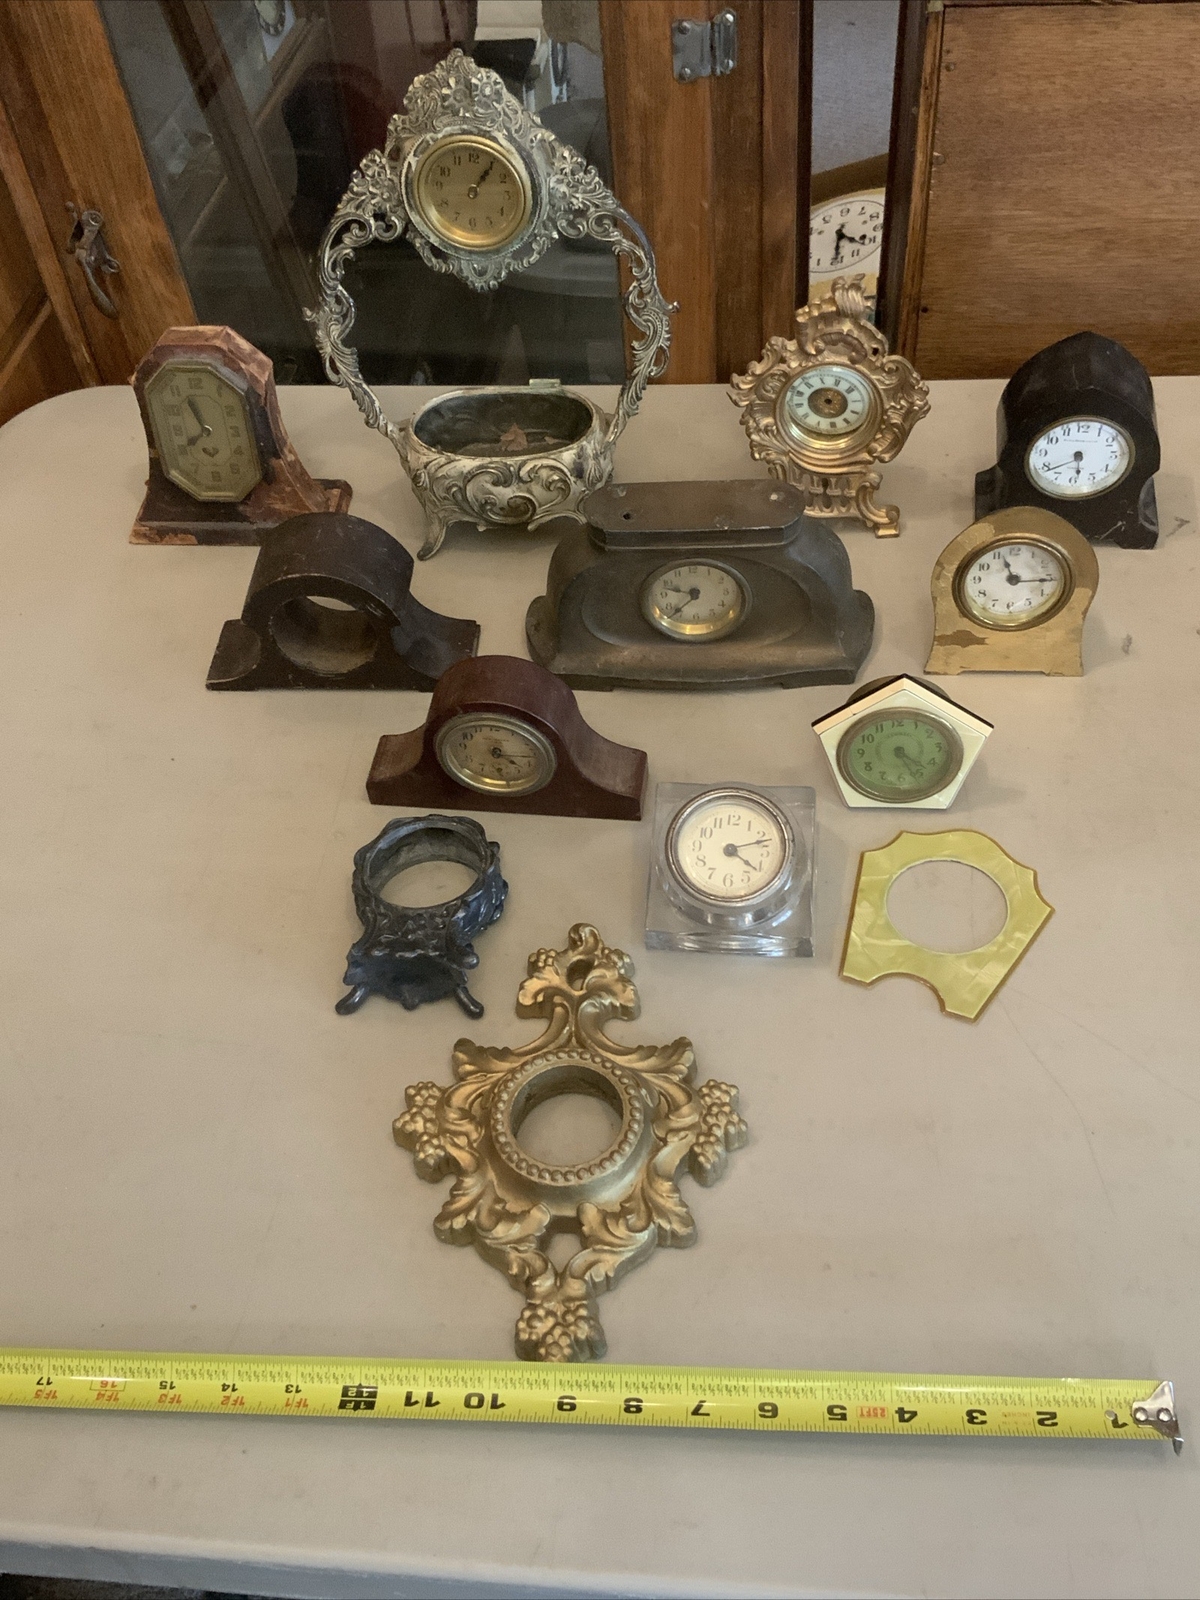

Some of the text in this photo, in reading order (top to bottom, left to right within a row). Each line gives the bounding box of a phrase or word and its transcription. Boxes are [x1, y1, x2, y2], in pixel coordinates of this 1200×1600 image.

[454, 155, 462, 166] 11
[468, 153, 480, 164] 12
[440, 167, 451, 177] 10
[436, 181, 443, 191] 9
[840, 208, 850, 217] 6
[858, 206, 867, 216] 7
[469, 217, 476, 228] 6
[852, 249, 860, 257] 11
[1063, 427, 1071, 437] 11
[1077, 422, 1090, 433] 12
[1097, 425, 1103, 437] 1
[1047, 434, 1059, 445] 10
[1106, 437, 1115, 447] 2
[1039, 448, 1048, 457] 9
[1042, 462, 1051, 472] 8
[1054, 472, 1062, 481] 7
[1069, 476, 1077, 485] 6
[1088, 473, 1096, 481] 5
[993, 552, 1001, 560] 11
[1009, 547, 1021, 556] 12
[689, 566, 698, 574] 12
[708, 568, 711, 576] 1
[978, 563, 990, 572] 10
[663, 579, 673, 587] 10
[718, 576, 724, 585] 2
[973, 575, 982, 584] 9
[660, 591, 668, 599] 9
[723, 588, 729, 596] 3
[978, 589, 987, 598] 8
[666, 602, 673, 610] 8
[718, 600, 726, 608] 4
[992, 599, 999, 607] 7
[1024, 598, 1032, 607] 5
[875, 723, 884, 734] 11
[891, 720, 904, 728] 12
[914, 721, 918, 730] 1
[861, 733, 875, 744] 10
[926, 729, 934, 739] 2
[934, 742, 942, 753] 3
[857, 748, 865, 758] 9
[864, 761, 872, 772] 8
[927, 757, 939, 767] 4
[879, 771, 887, 781] 7
[898, 773, 906, 783] 6
[916, 769, 924, 779] 5
[714, 817, 723, 829] 11
[727, 814, 741, 826] 12
[747, 820, 752, 832] 1
[700, 827, 713, 839] 10
[692, 840, 702, 852] 9
[695, 854, 707, 868] 8
[707, 868, 717, 880] 7
[741, 871, 751, 884] 5
[723, 873, 734, 888] 6
[36, 1376, 53, 1386] 17
[100, 1380, 117, 1388] 16
[159, 1380, 176, 1390] 15
[221, 1382, 238, 1392] 14
[285, 1384, 302, 1394] 13
[348, 1387, 369, 1397] 12
[404, 1391, 441, 1407] 11
[463, 1392, 506, 1410] 10
[557, 1395, 577, 1412] 9
[623, 1397, 643, 1414] 8
[691, 1400, 710, 1416] 7
[757, 1402, 778, 1419] 6
[826, 1404, 847, 1421] 5
[859, 1407, 886, 1418] 25FT
[895, 1407, 918, 1423] 4
[965, 1409, 988, 1425] 3
[1036, 1411, 1059, 1427] 2
